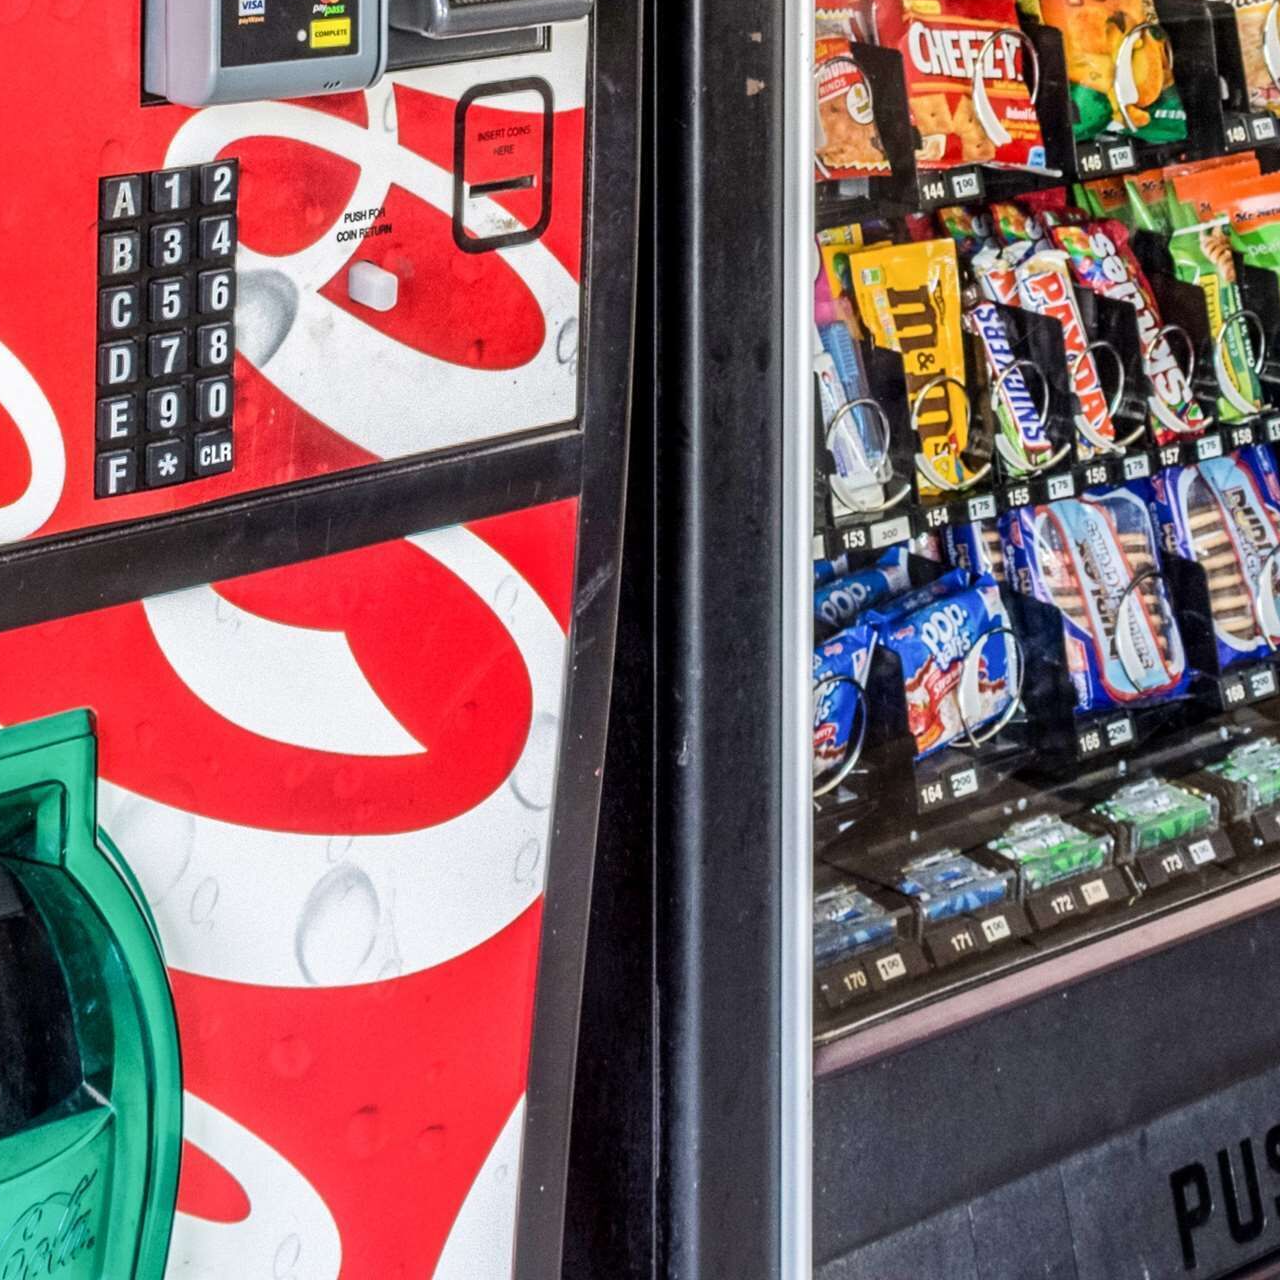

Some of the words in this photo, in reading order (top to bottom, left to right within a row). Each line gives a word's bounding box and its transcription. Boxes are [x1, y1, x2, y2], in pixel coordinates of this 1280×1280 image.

[242, 0, 263, 10] VISA
[315, 29, 347, 38] COMPLETE
[478, 130, 505, 142] INSERT
[508, 126, 532, 137] COINS
[493, 144, 514, 155] HERE
[112, 181, 135, 219] A
[165, 173, 179, 209] 1
[214, 166, 231, 202] 2
[922, 183, 944, 199] 144
[344, 209, 367, 223] PUSH
[368, 207, 385, 219] FOR
[337, 228, 358, 242] COIN
[359, 223, 392, 239] RETURN
[112, 238, 133, 274] B
[163, 228, 182, 264] 3
[212, 220, 231, 255] 4
[111, 291, 132, 329] C
[162, 283, 180, 319] 5
[212, 275, 229, 310] 6
[110, 348, 131, 384] D
[161, 338, 180, 374] 7
[210, 328, 227, 365] 8
[975, 306, 1045, 443] SNICKERS
[111, 400, 128, 438] E
[160, 392, 178, 428] 9
[209, 382, 226, 418] 0
[1233, 428, 1252, 445] 158
[1160, 448, 1179, 464] 157
[109, 457, 127, 494] F
[201, 443, 231, 466] CLR
[1086, 467, 1107, 484] 156
[1008, 487, 1029, 505] 155
[926, 508, 949, 526] 154
[843, 530, 866, 548] 153
[1080, 733, 1100, 752] 166
[922, 785, 943, 804] 164
[1162, 854, 1183, 873] 173
[1051, 894, 1073, 915] 172
[951, 932, 973, 952] 171
[844, 971, 867, 991] 170
